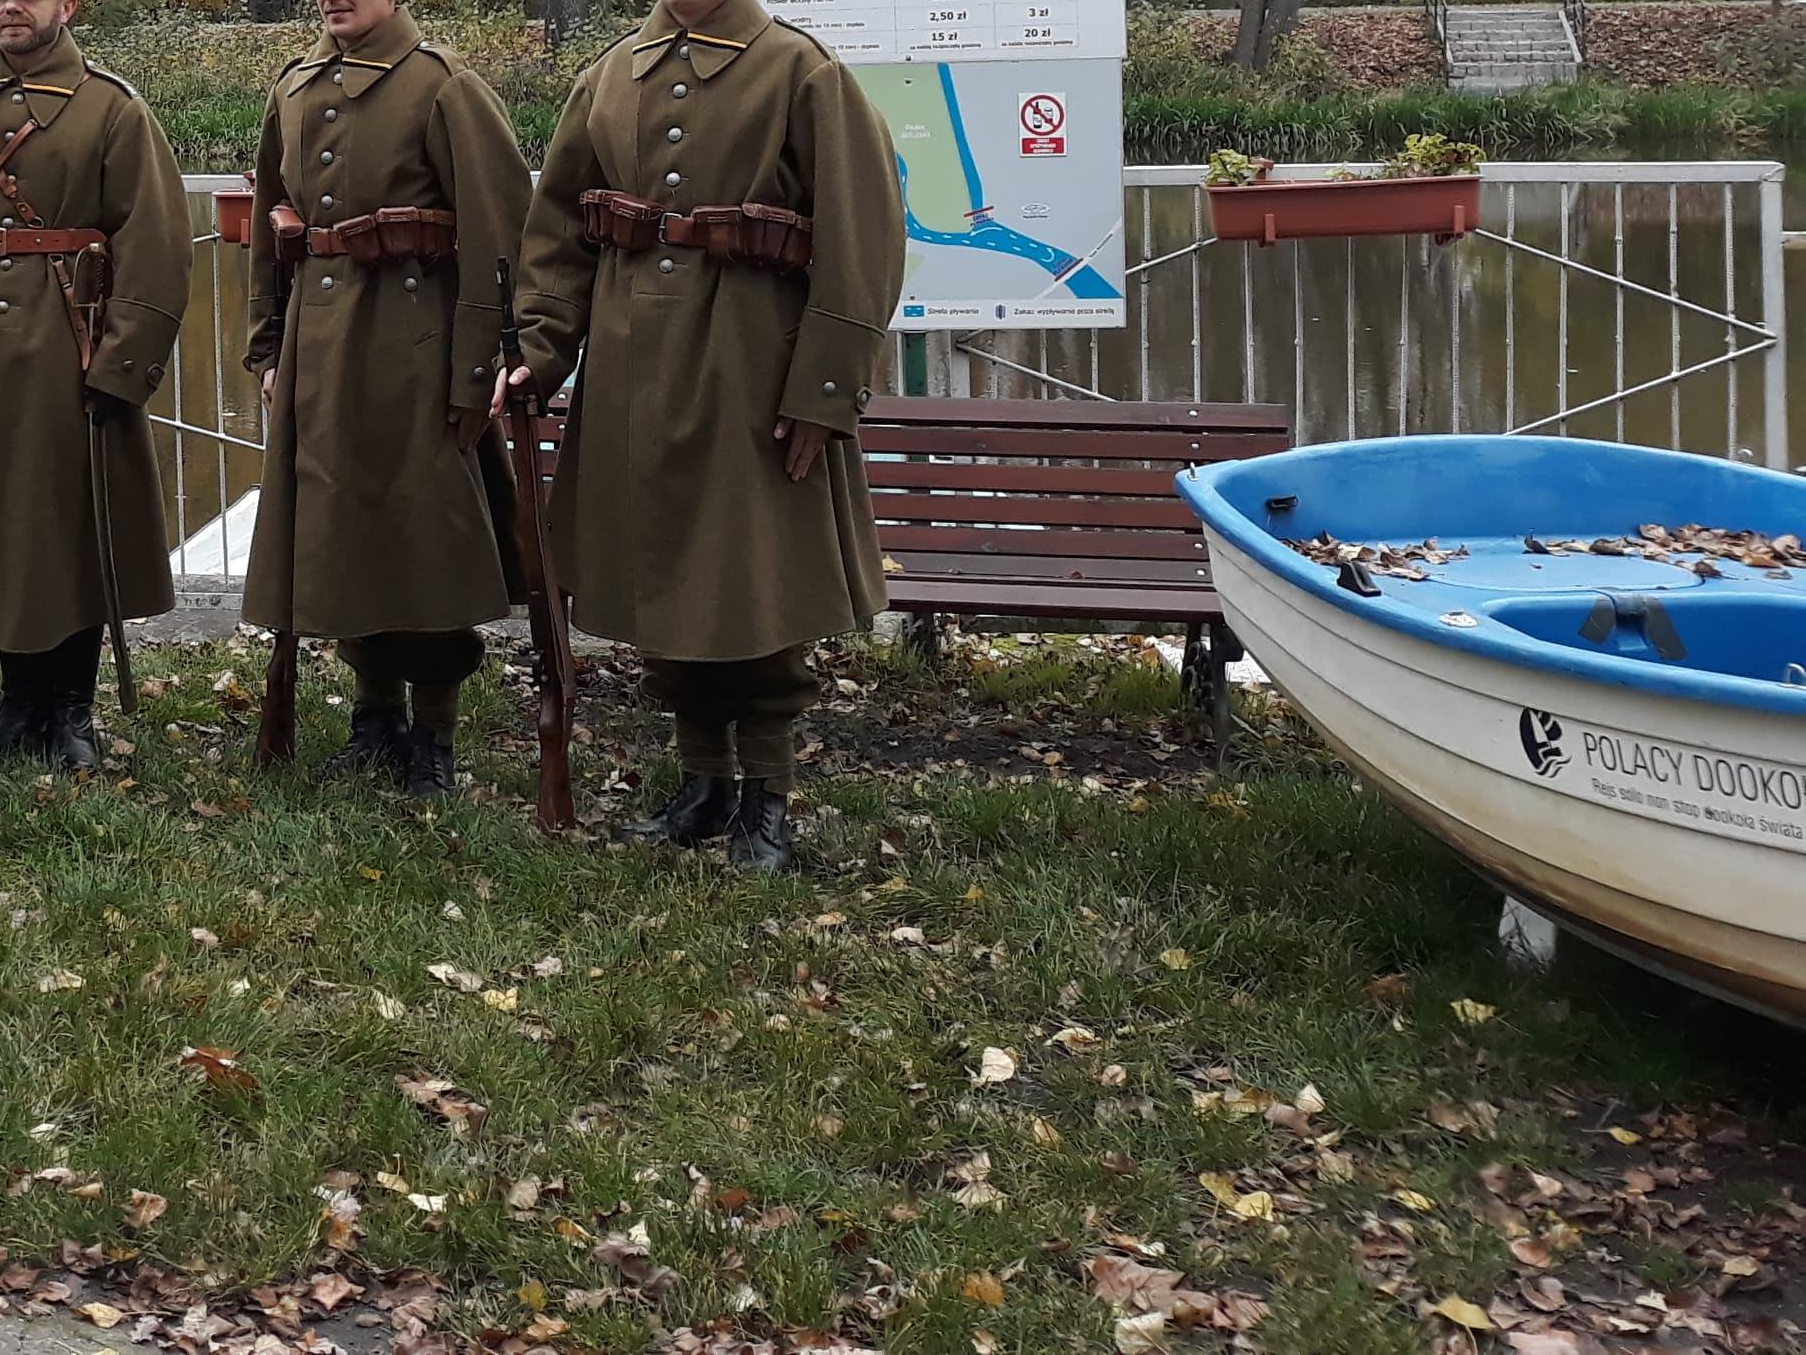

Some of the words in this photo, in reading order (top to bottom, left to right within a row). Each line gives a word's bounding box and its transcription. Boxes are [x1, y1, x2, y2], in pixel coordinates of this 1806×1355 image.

[930, 11, 954, 22] 2,50
[957, 10, 966, 20] zł
[1029, 8, 1035, 17] 3
[1039, 7, 1049, 16] zł
[932, 32, 944, 41] 15
[948, 31, 957, 41] zł
[1024, 28, 1038, 37] 20
[1041, 28, 1051, 37] zł
[1583, 731, 1683, 786] POLACY
[1693, 753, 1806, 810] DOOKO
